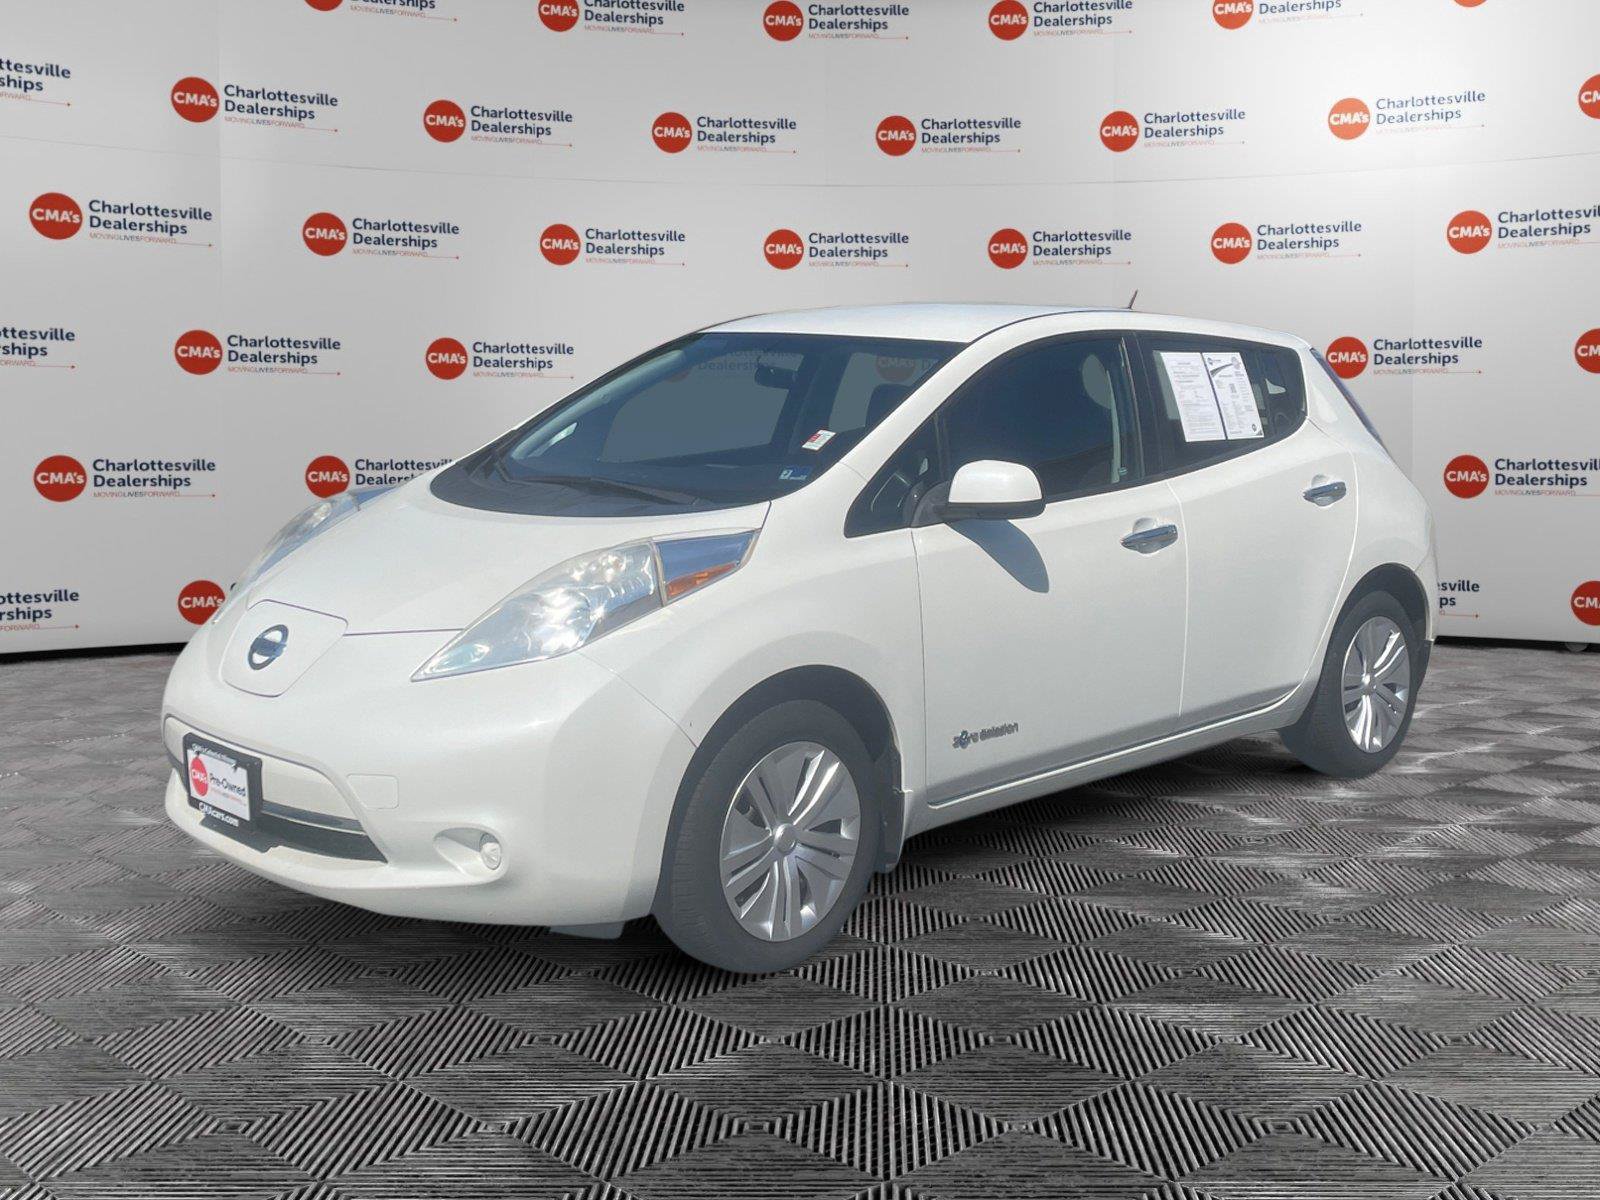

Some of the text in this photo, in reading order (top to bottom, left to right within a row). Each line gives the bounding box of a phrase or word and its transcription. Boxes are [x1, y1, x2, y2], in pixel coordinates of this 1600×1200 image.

[350, 0, 436, 10] alerships
[540, 5, 578, 18] CMA's
[583, 0, 685, 11] Charlottesville
[808, 4, 910, 17] Charlottesville
[1033, 0, 1134, 13] Charlottesville
[1214, 3, 1252, 15] CMA's
[1258, 0, 1342, 15] Dealerships
[583, 10, 665, 27] Dealerships
[766, 14, 802, 27] CMA's
[808, 18, 889, 33] Dealerships
[990, 13, 1028, 26] CMA's
[1033, 14, 1113, 28] Dealerships
[173, 91, 218, 108] CMA's
[224, 84, 339, 107] Charlottesville
[1376, 91, 1487, 111] Charlottesville
[224, 100, 316, 121] Dealerships
[470, 105, 573, 123] Charlottesville
[1143, 108, 1247, 125] Charlottesville
[1376, 108, 1462, 126] Dealerships
[425, 114, 464, 128] CMA's
[696, 116, 797, 130] Charlottesville
[920, 117, 1022, 131] Charlottesville
[1329, 113, 1370, 126] CMA's
[471, 120, 552, 138] Dealerships
[653, 126, 690, 138] CMA's
[878, 130, 915, 142] CMA's
[1101, 125, 1138, 137] CMA's
[1143, 124, 1225, 139] Dealerships
[697, 130, 776, 144] Dealerships
[921, 132, 1001, 146] Dealerships
[32, 208, 80, 224] CMA's
[89, 199, 213, 221] Charlottesville
[89, 215, 188, 236] Dealerships
[352, 217, 460, 235] Charlottesville
[1257, 220, 1362, 237] Charlottesville
[1448, 225, 1490, 240] CMA's
[1498, 219, 1591, 240] Dealerships
[305, 227, 346, 241] CMA's
[352, 232, 438, 250] Dealerships
[585, 227, 686, 243] Charlottesville
[808, 231, 910, 245] Charlottesville
[1032, 229, 1132, 243] Charlottesville
[541, 237, 579, 251] CMA's
[585, 242, 665, 257] Dealerships
[765, 243, 802, 255] CMA's
[989, 243, 1026, 255] CMA's
[1032, 243, 1112, 258] Dealerships
[1212, 237, 1250, 249] CMA's
[1257, 235, 1340, 251] Dealerships
[808, 245, 889, 260] Dealerships
[0, 326, 76, 342] ttesville
[227, 334, 341, 350] Charlottesville
[472, 341, 575, 356] Charlottesville
[1373, 336, 1484, 352] Charlottesville
[0, 342, 48, 358] ships
[176, 345, 221, 359] CMA's
[1327, 351, 1367, 364] CMA's
[227, 349, 318, 367] Dealerships
[428, 352, 466, 365] CMA's
[472, 356, 553, 371] Dealerships
[1373, 352, 1459, 367] Dealerships
[92, 458, 216, 473] Charlottesville
[36, 471, 85, 485] CMA's
[93, 474, 191, 492] Dealerships
[307, 470, 348, 484] CMA's
[1446, 470, 1487, 483] CMA's
[1494, 473, 1588, 490] Dealerships
[1437, 579, 1480, 593] sville
[180, 596, 224, 609] CMA's
[1573, 595, 1600, 607] CM
